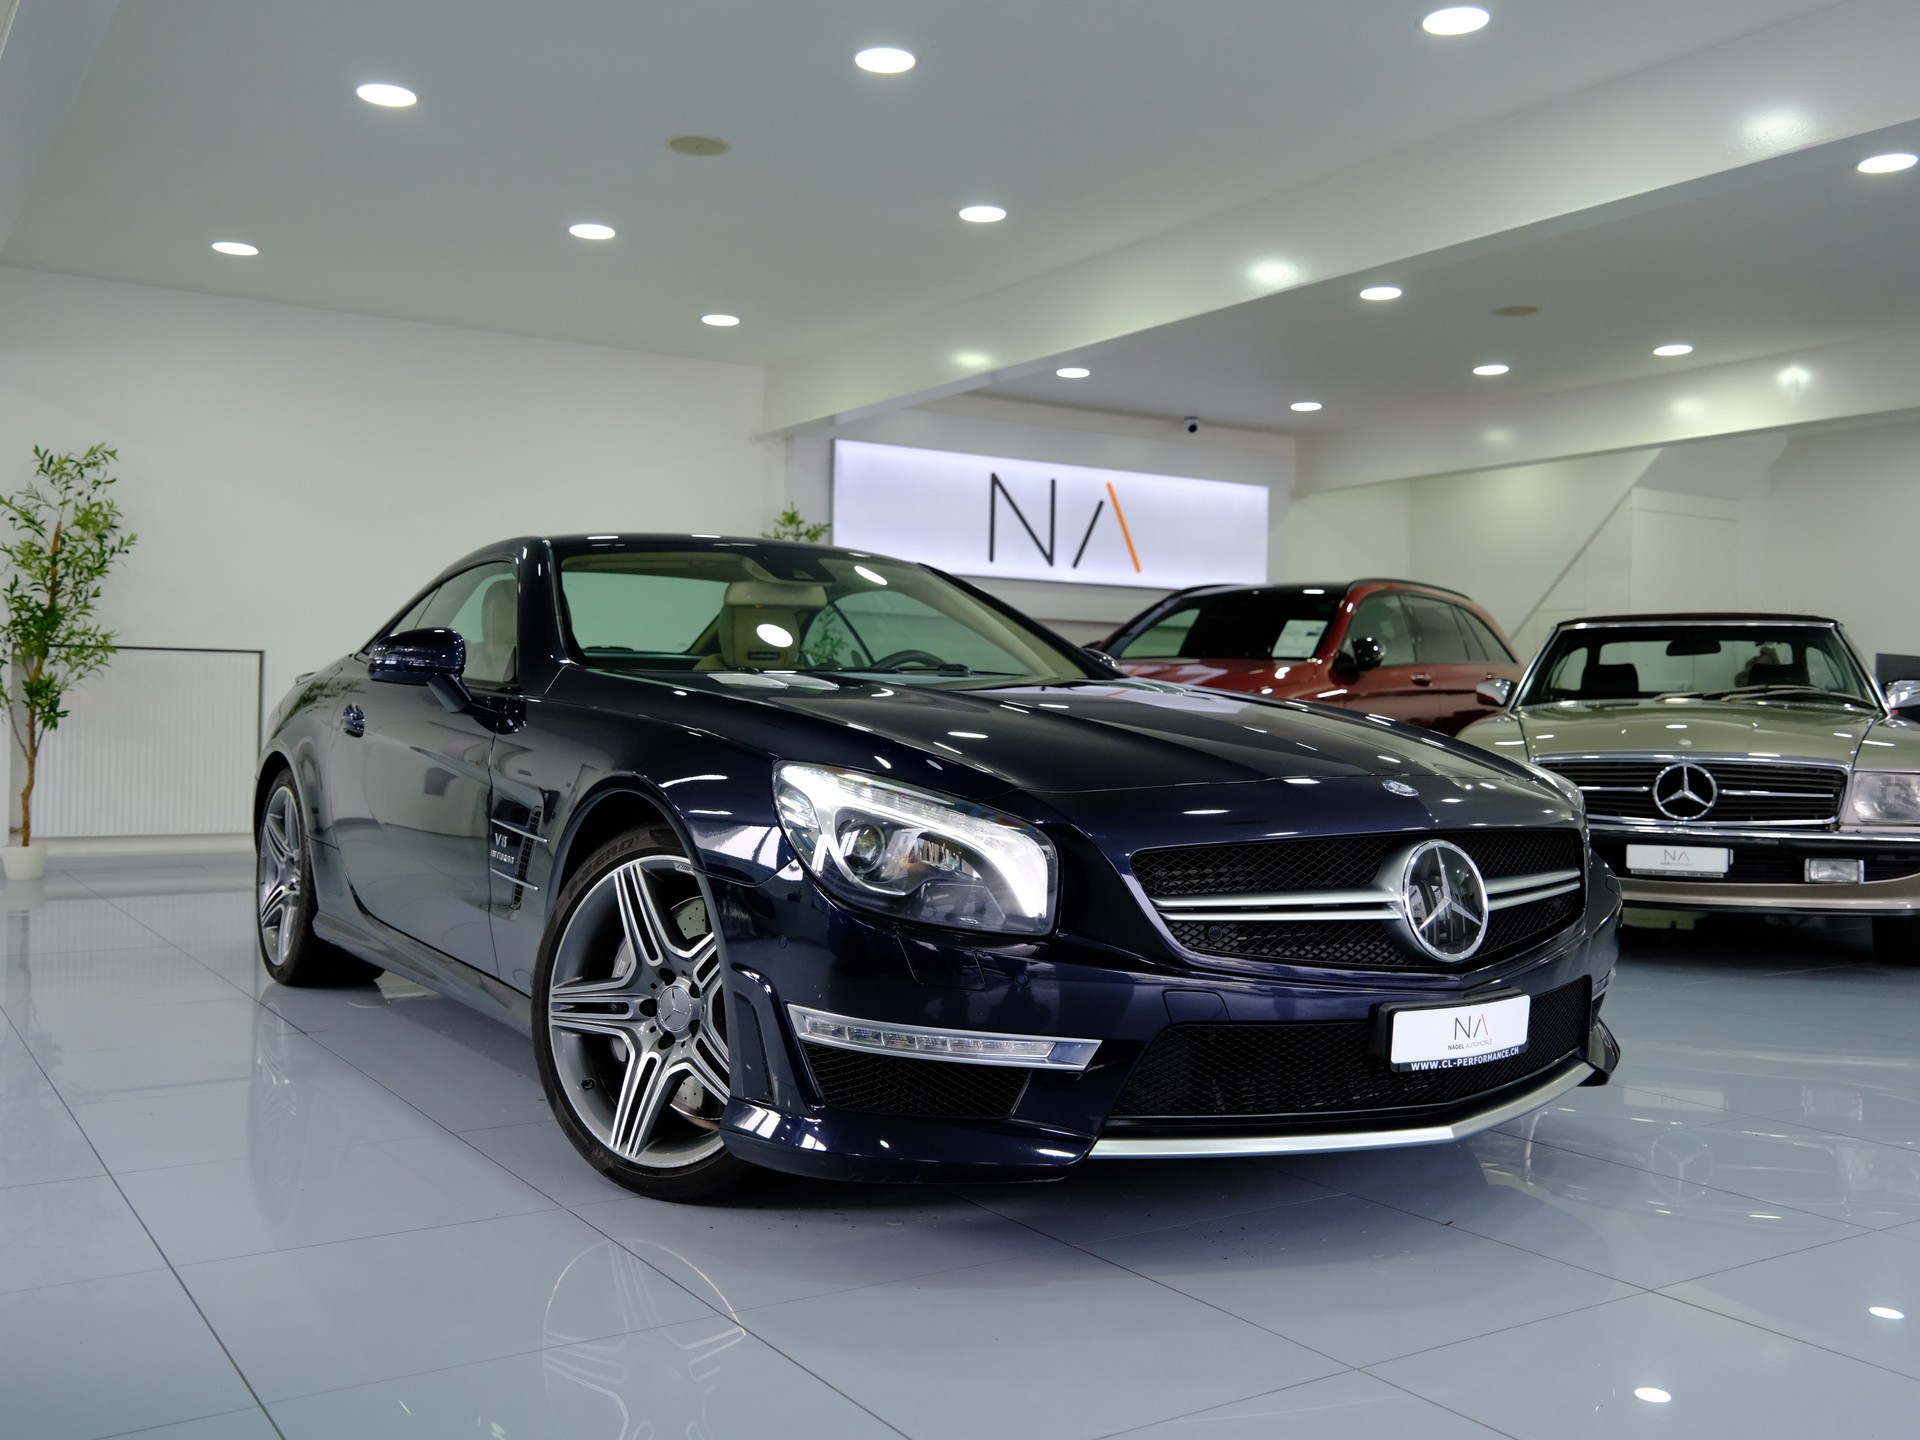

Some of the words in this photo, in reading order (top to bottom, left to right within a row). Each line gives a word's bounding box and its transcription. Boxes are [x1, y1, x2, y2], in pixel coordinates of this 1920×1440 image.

[989, 472, 1141, 573] NA
[1454, 1013, 1489, 1041] NA
[1447, 1043, 1465, 1051] NAGEL
[1465, 1038, 1493, 1049] AUTOMOBILE
[1410, 1046, 1520, 1071] WWW.CL-PERFORMANCE.CH
